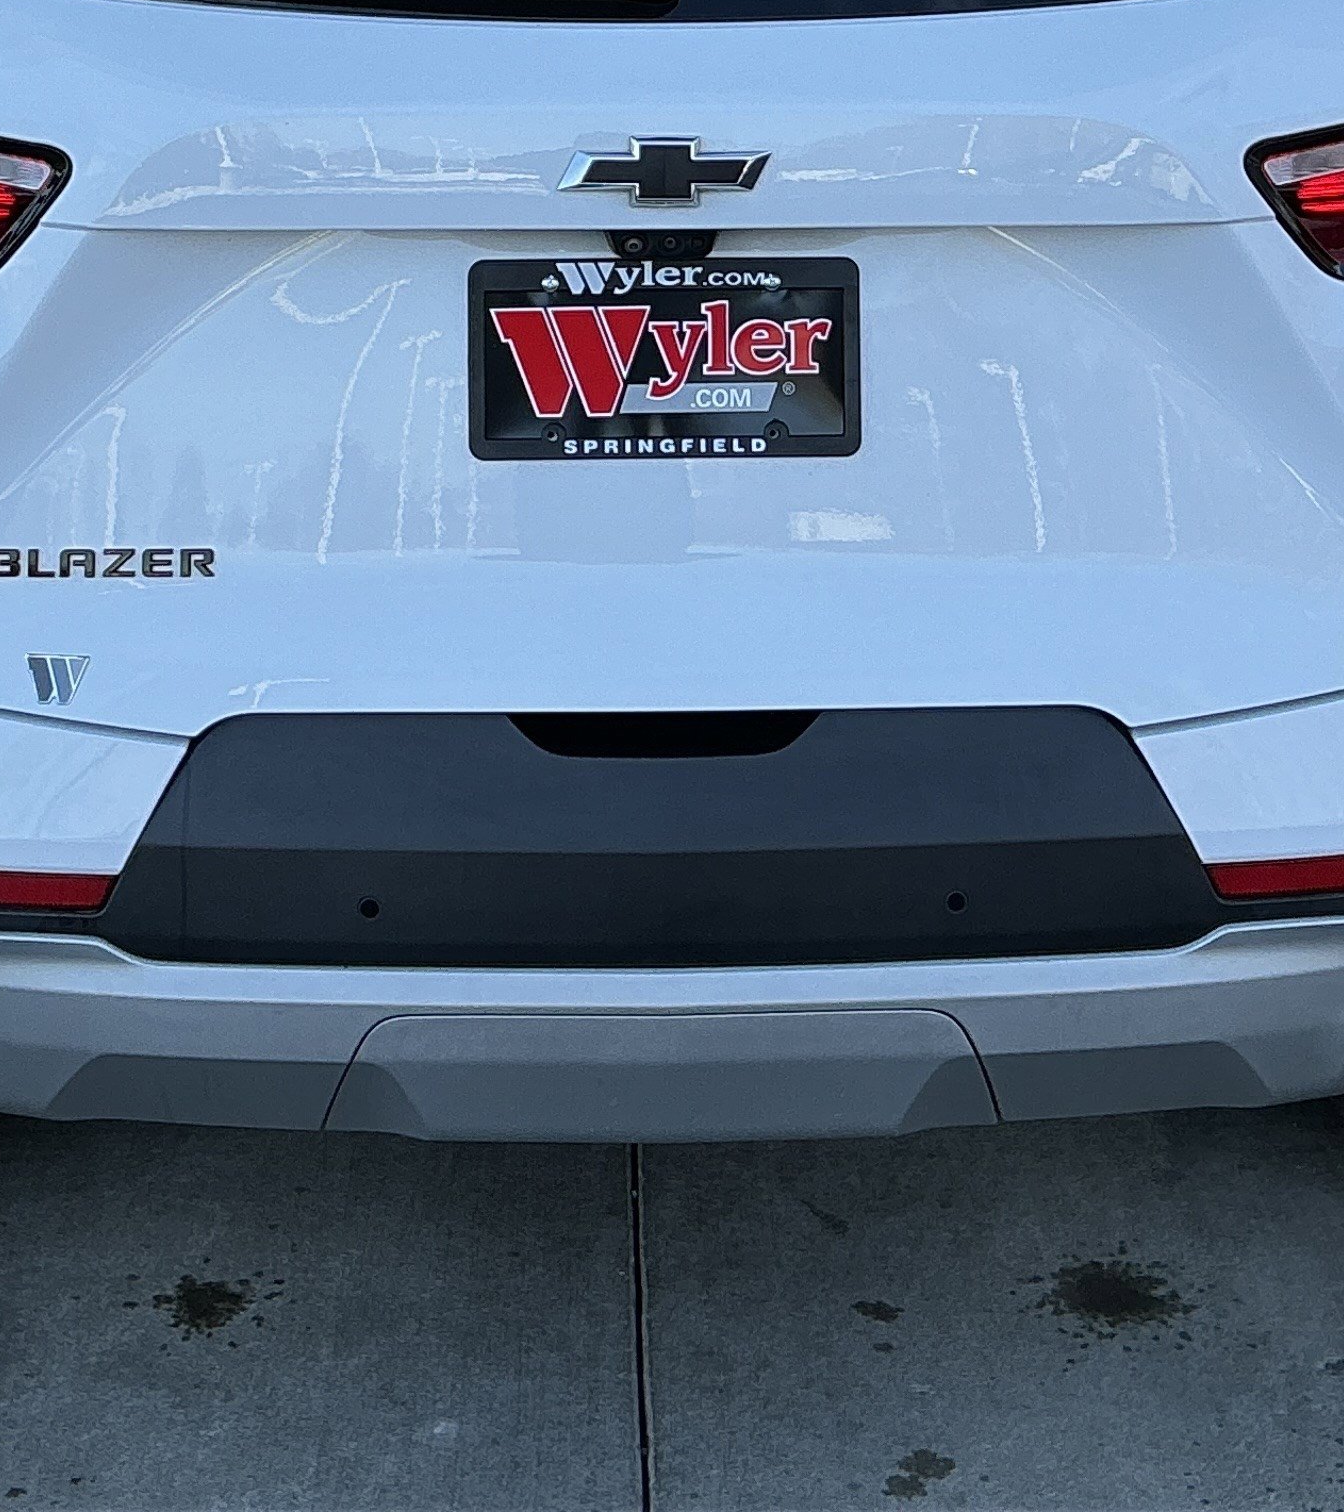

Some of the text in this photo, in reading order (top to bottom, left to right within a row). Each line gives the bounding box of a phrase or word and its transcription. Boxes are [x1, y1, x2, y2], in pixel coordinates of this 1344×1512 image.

[489, 300, 833, 418] Wyler
[690, 388, 752, 408] .COM
[563, 438, 768, 454] SPRINGFIELD
[25, 652, 91, 705] W
